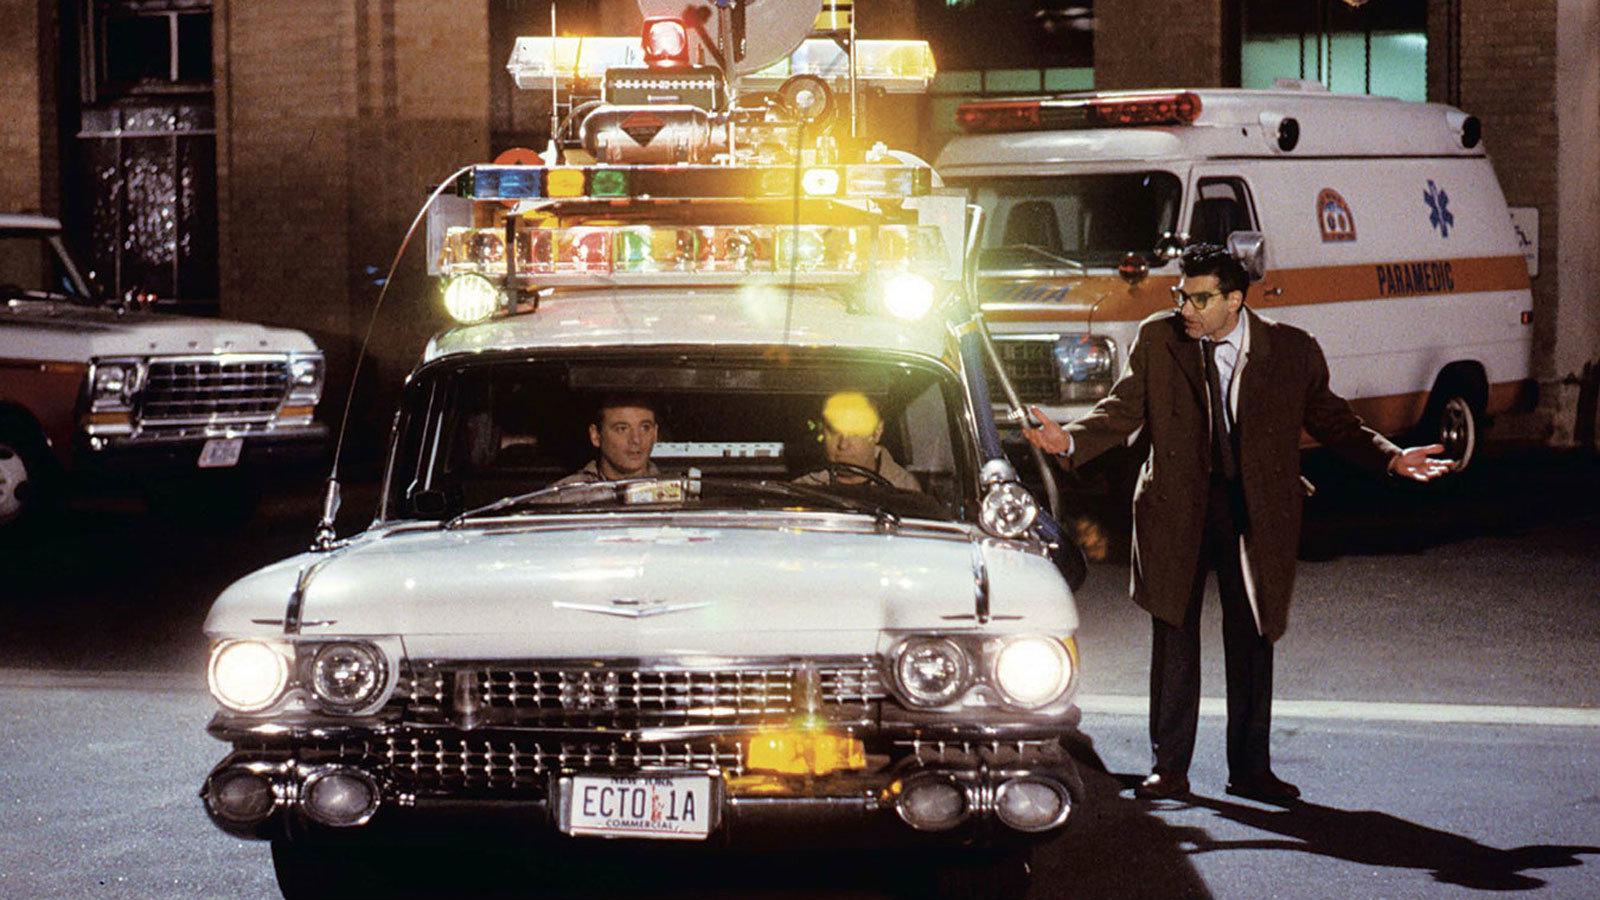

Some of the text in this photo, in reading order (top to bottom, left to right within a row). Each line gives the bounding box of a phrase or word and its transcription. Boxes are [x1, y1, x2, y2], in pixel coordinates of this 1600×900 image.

[1376, 262, 1454, 295] PARAMEDIC
[583, 785, 696, 821] ECTO 1A
[605, 818, 674, 830] COMMERCIAL
